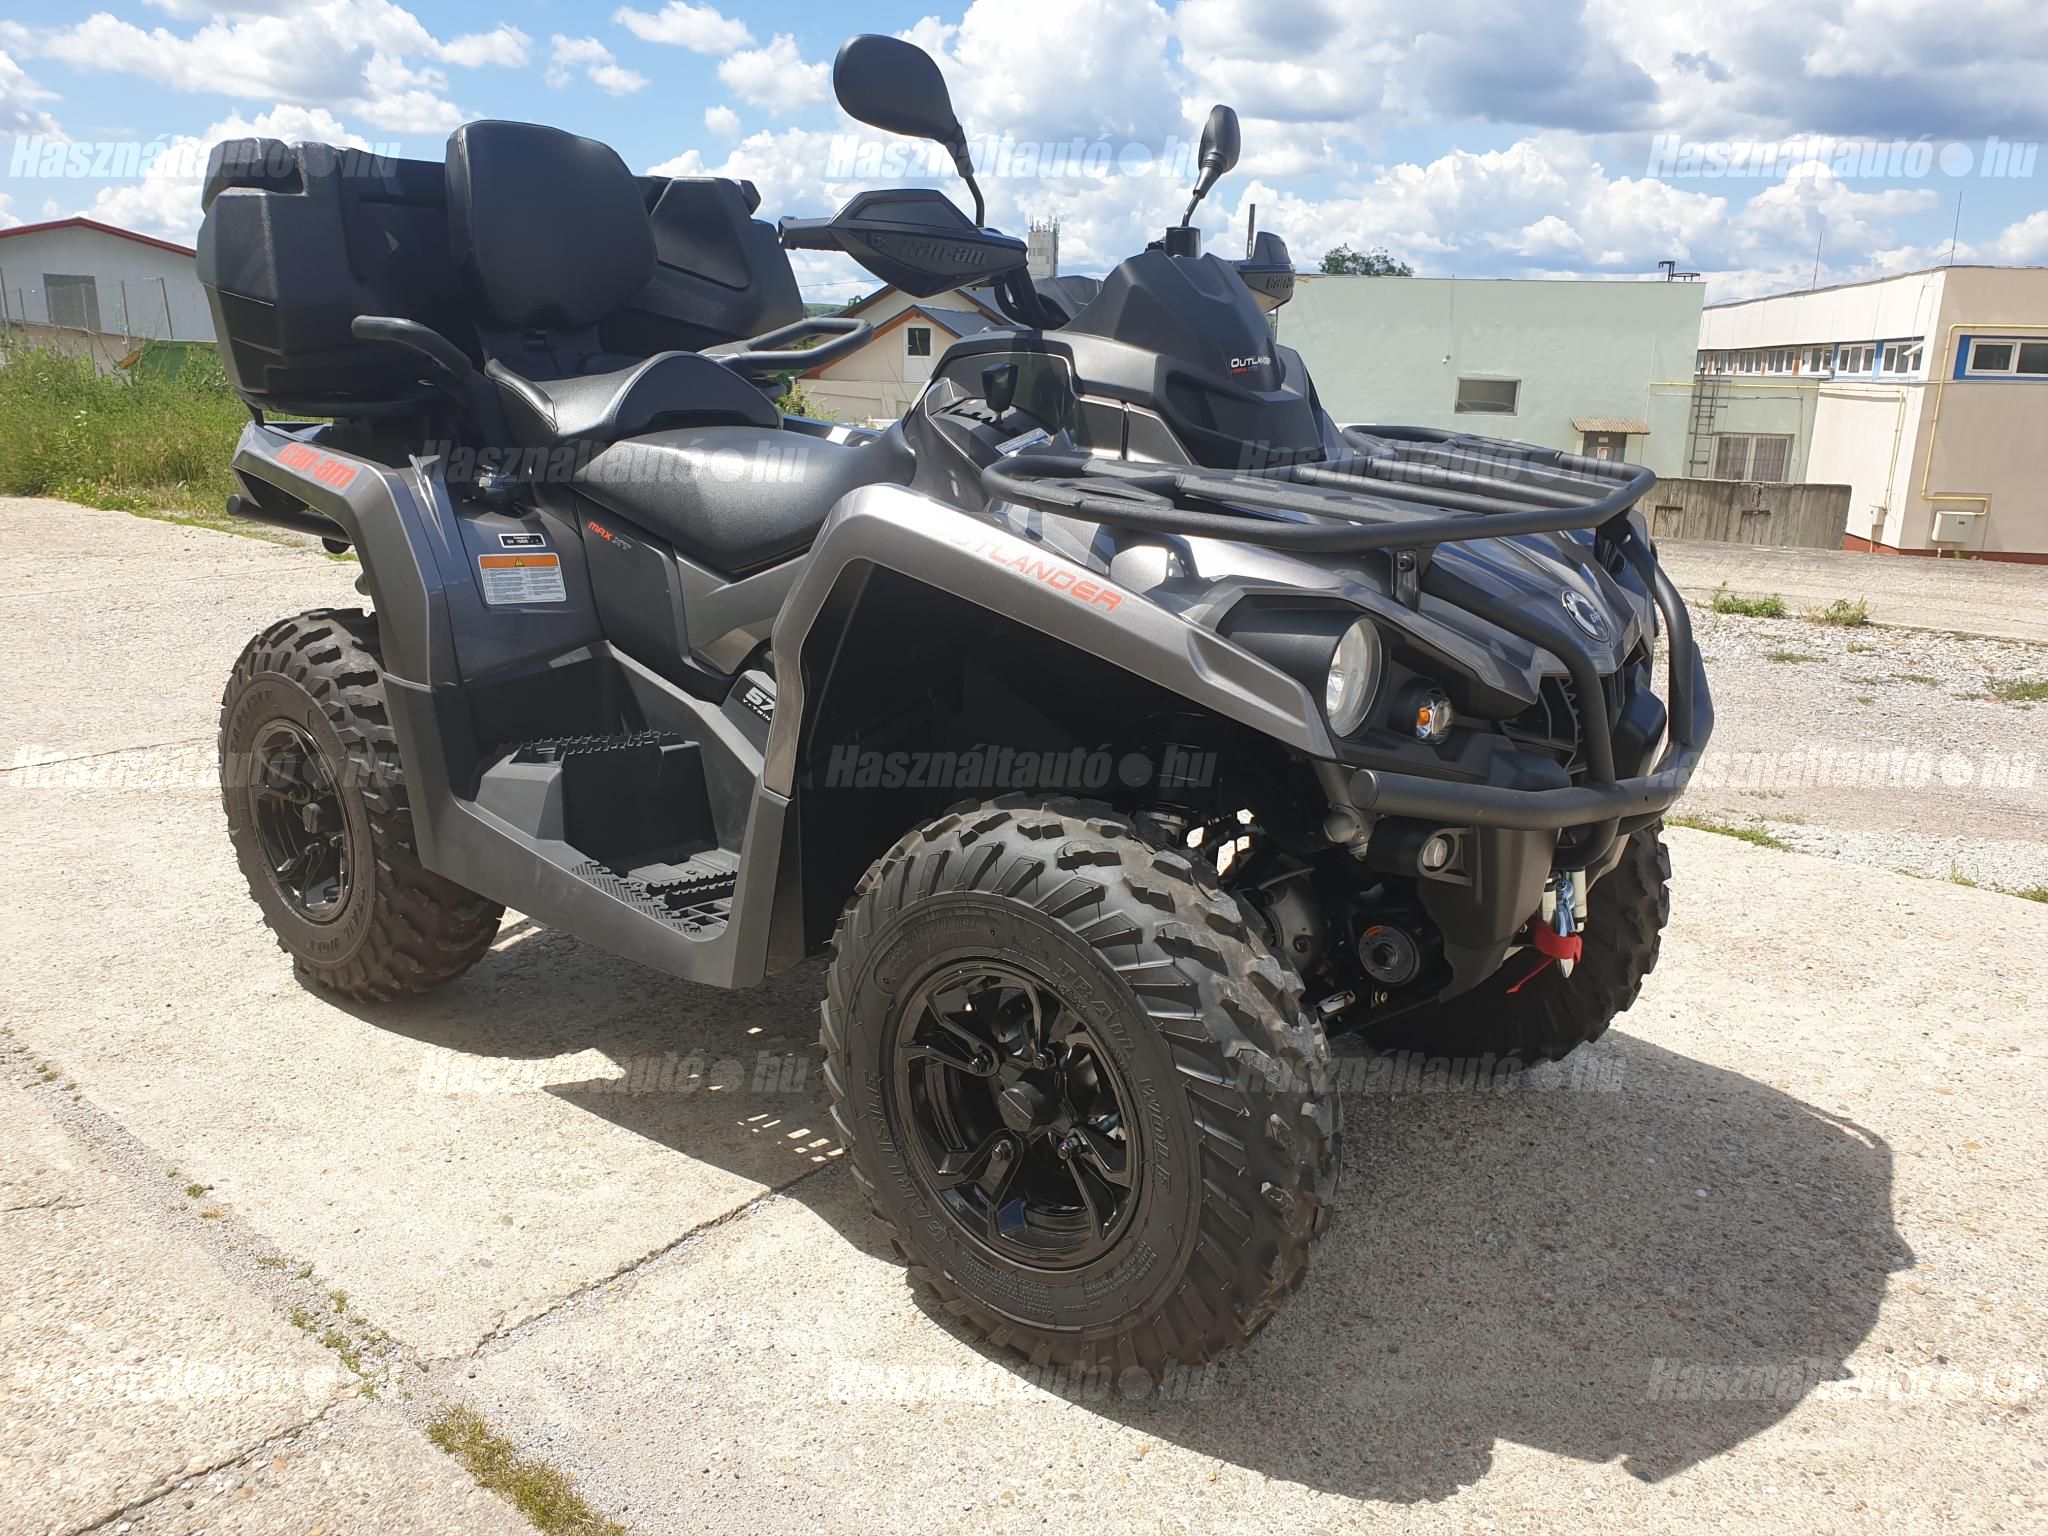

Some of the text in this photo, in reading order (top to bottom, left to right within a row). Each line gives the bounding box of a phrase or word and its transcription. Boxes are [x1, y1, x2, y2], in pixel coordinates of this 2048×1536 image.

[276, 442, 357, 490] can-am
[587, 520, 614, 542] MAX
[1056, 956, 1136, 1063] TRAIL
